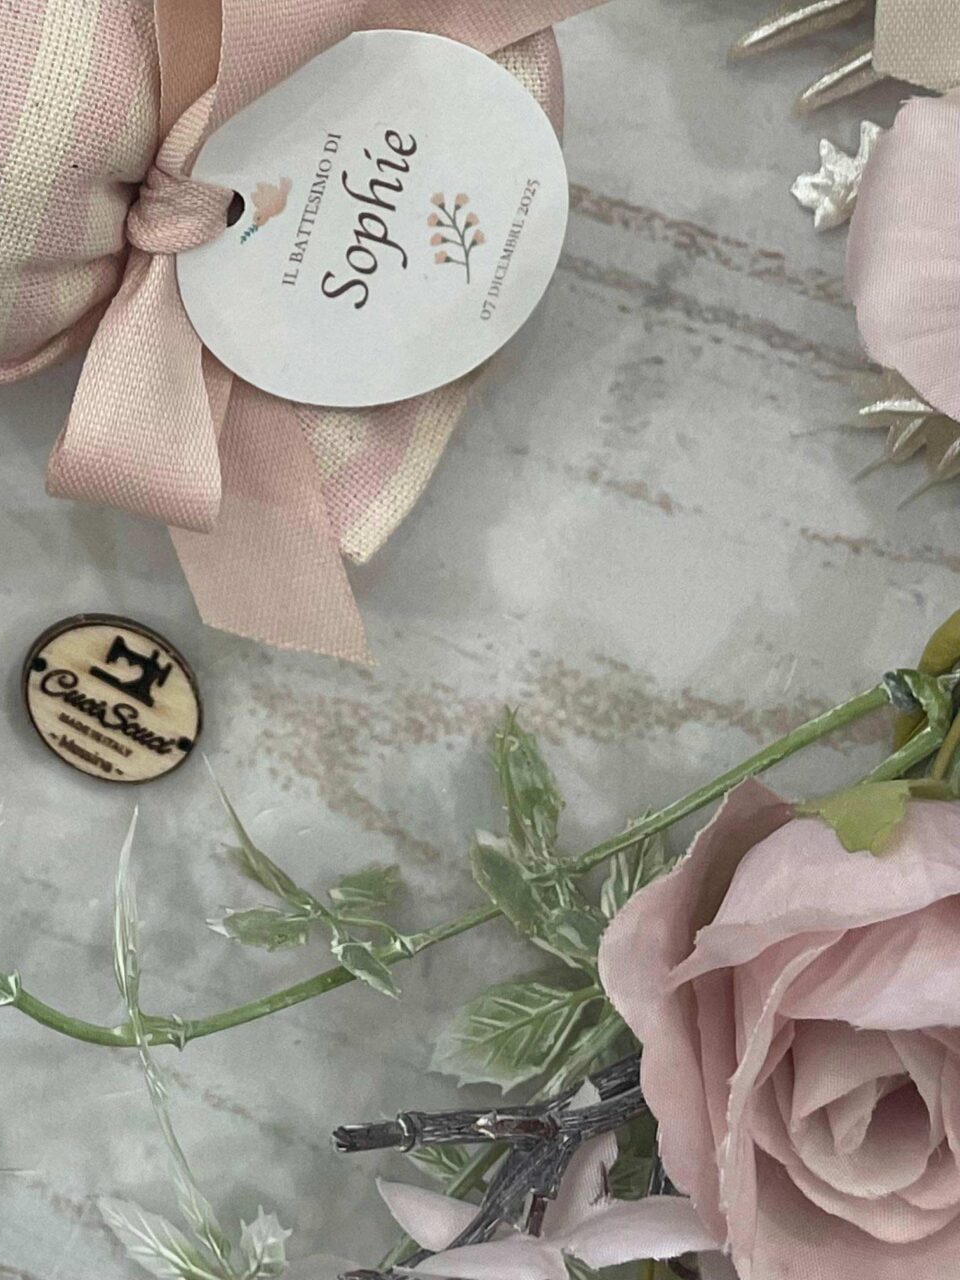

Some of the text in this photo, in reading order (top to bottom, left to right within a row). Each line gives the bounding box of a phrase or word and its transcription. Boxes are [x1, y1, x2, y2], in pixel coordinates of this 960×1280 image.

[282, 132, 342, 287] IL BATTESIMO DI
[320, 128, 418, 310] Sophie
[479, 178, 541, 321] 07 DICEMBRE 2025
